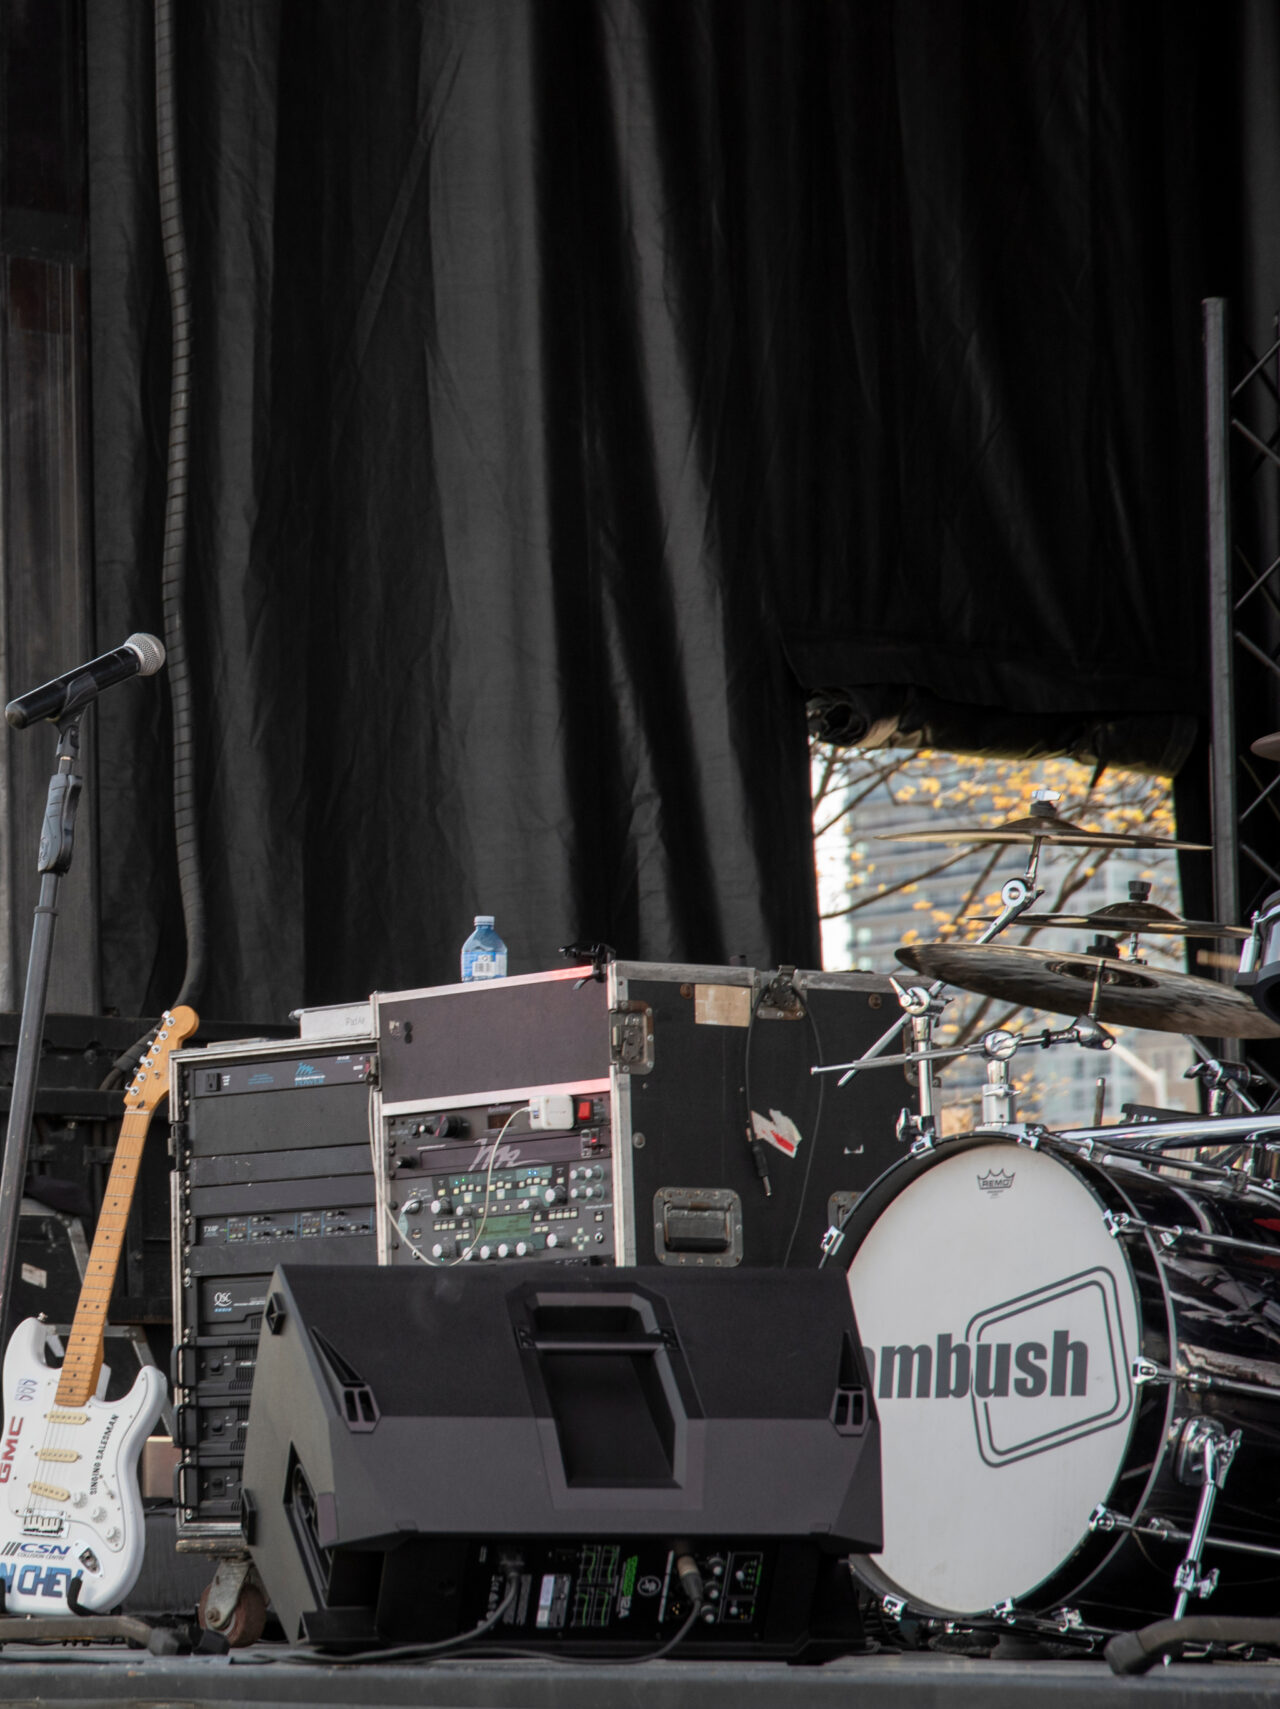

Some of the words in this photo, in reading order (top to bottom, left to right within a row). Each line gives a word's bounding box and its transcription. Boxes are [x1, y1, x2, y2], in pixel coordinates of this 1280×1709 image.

[982, 1179, 1010, 1187] REMO
[214, 1292, 232, 1307] QSC
[95, 1413, 120, 1461] SALESMAN
[89, 1461, 102, 1495] SINGING
[20, 1542, 71, 1555] CSN
